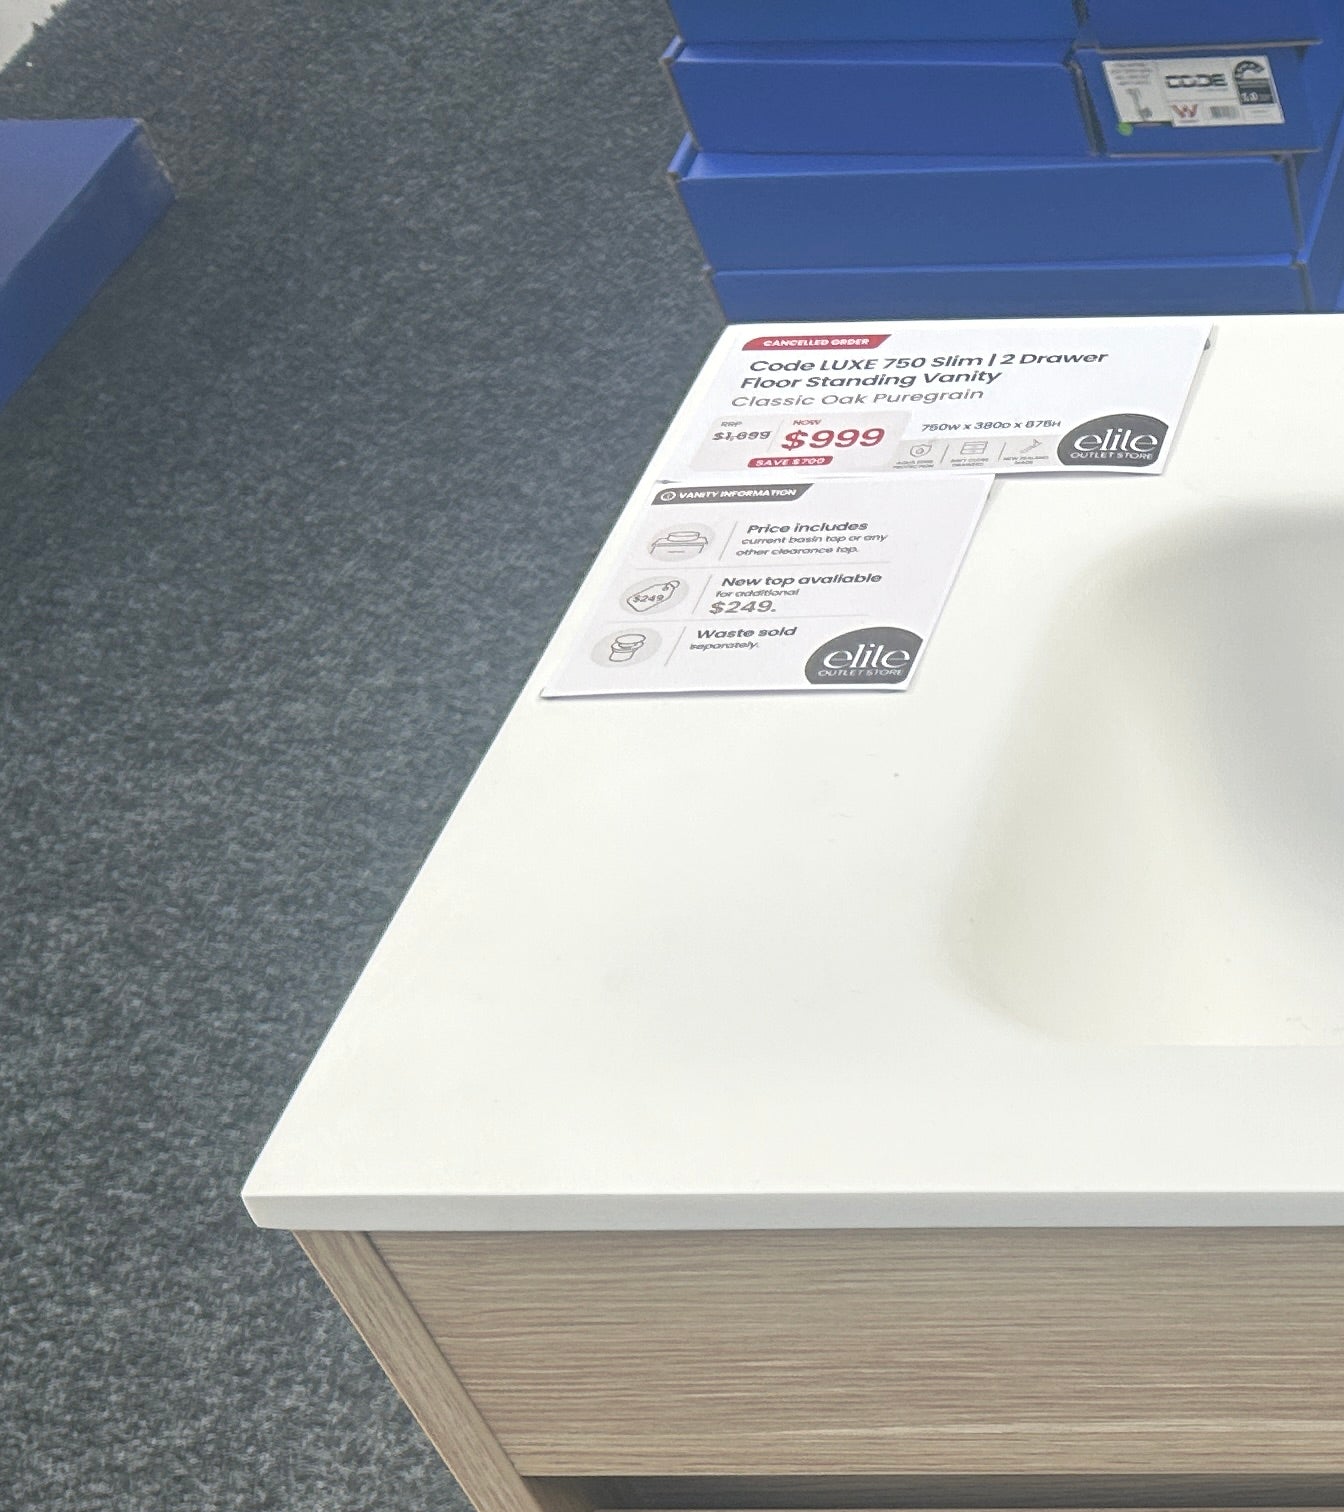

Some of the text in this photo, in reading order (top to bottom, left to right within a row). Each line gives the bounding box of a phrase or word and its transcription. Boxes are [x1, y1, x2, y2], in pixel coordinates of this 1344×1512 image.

[763, 338, 870, 347] CANCELLED ORDER
[750, 360, 815, 372] Code
[820, 359, 878, 371] LUXE
[883, 357, 926, 370] 750
[930, 354, 982, 367] Slim
[1000, 354, 1016, 365] 2
[1020, 353, 1109, 364] Drawer
[740, 371, 1003, 389] Floor Standing Vanity
[731, 389, 984, 407] Classic Oak Puregrain
[963, 422, 971, 430] x
[1013, 421, 1022, 429] x
[781, 428, 885, 451] $999
[1070, 452, 1153, 460] OUTLET STORE
[756, 457, 825, 467] SAVE $700
[679, 489, 797, 499] VANITY INFORMATION
[747, 522, 868, 534] Price includes
[742, 537, 786, 545] current
[789, 536, 822, 544] basin
[826, 535, 846, 543] top
[864, 534, 888, 543] any
[736, 548, 769, 556] other
[771, 547, 833, 555] clearance
[721, 573, 882, 588] New top available
[716, 589, 800, 598] for additional
[709, 600, 776, 615] $249.
[697, 626, 798, 639] Waste sold
[818, 668, 903, 677] OUTLET STORE
